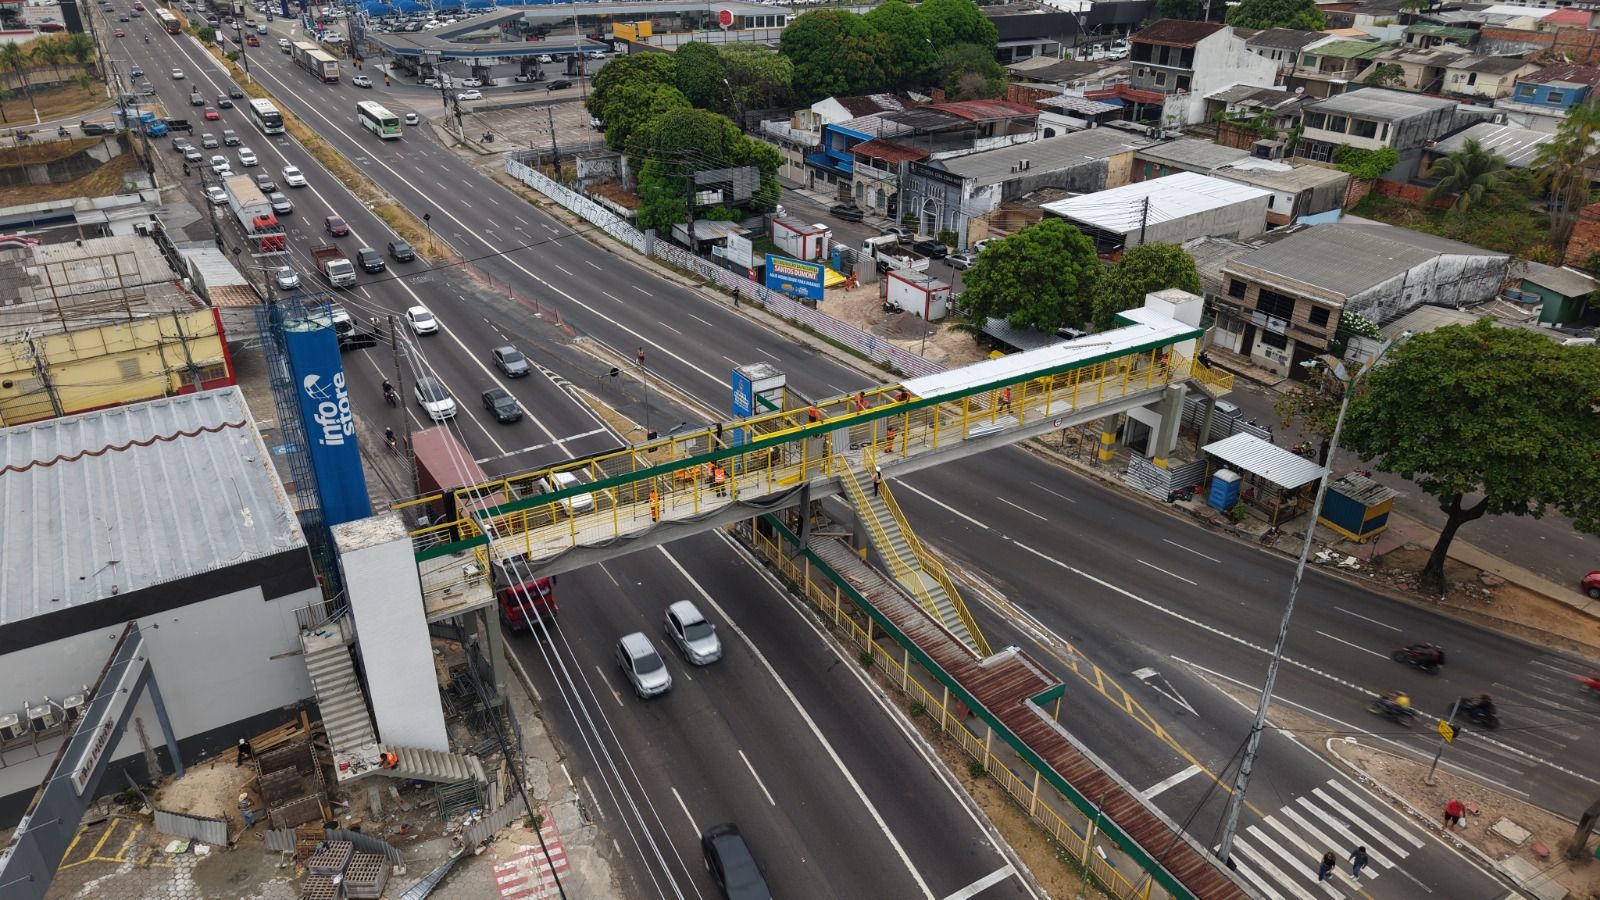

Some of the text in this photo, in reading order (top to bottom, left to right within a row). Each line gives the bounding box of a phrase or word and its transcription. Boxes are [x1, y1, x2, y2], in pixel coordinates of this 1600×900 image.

[774, 265, 817, 280] SANTOS DUMONT
[314, 402, 344, 445] info
[334, 372, 354, 435] store
